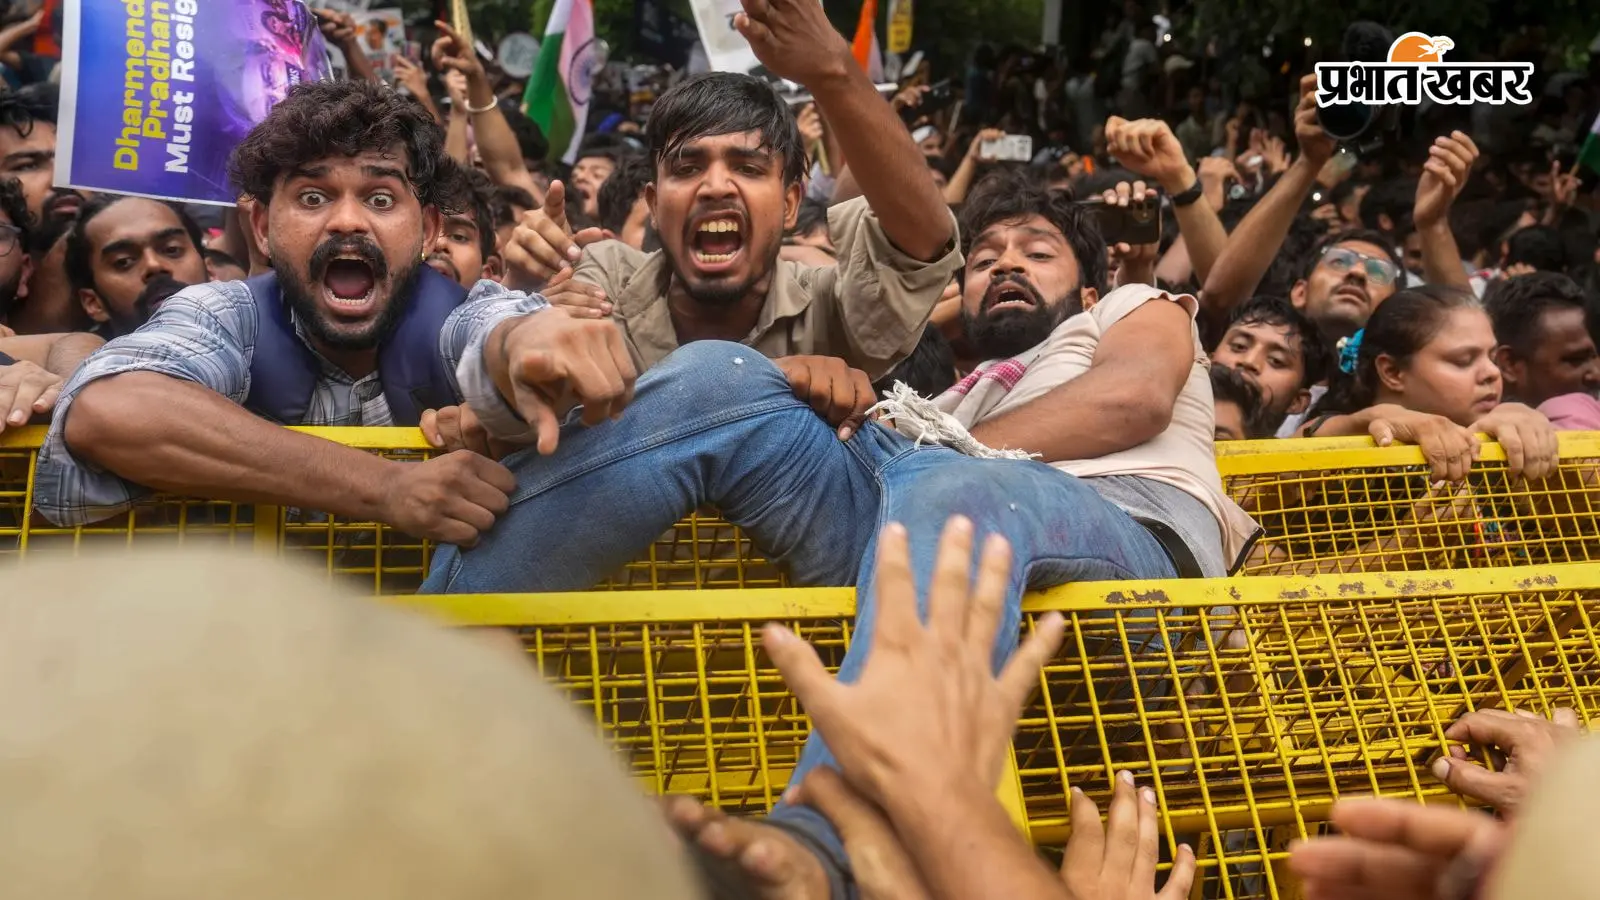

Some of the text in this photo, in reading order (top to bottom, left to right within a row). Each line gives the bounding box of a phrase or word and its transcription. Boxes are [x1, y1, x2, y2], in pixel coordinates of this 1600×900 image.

[113, 0, 145, 171] Dharmend
[142, 1, 171, 139] Pradhan
[165, 0, 199, 173] Must Resig
